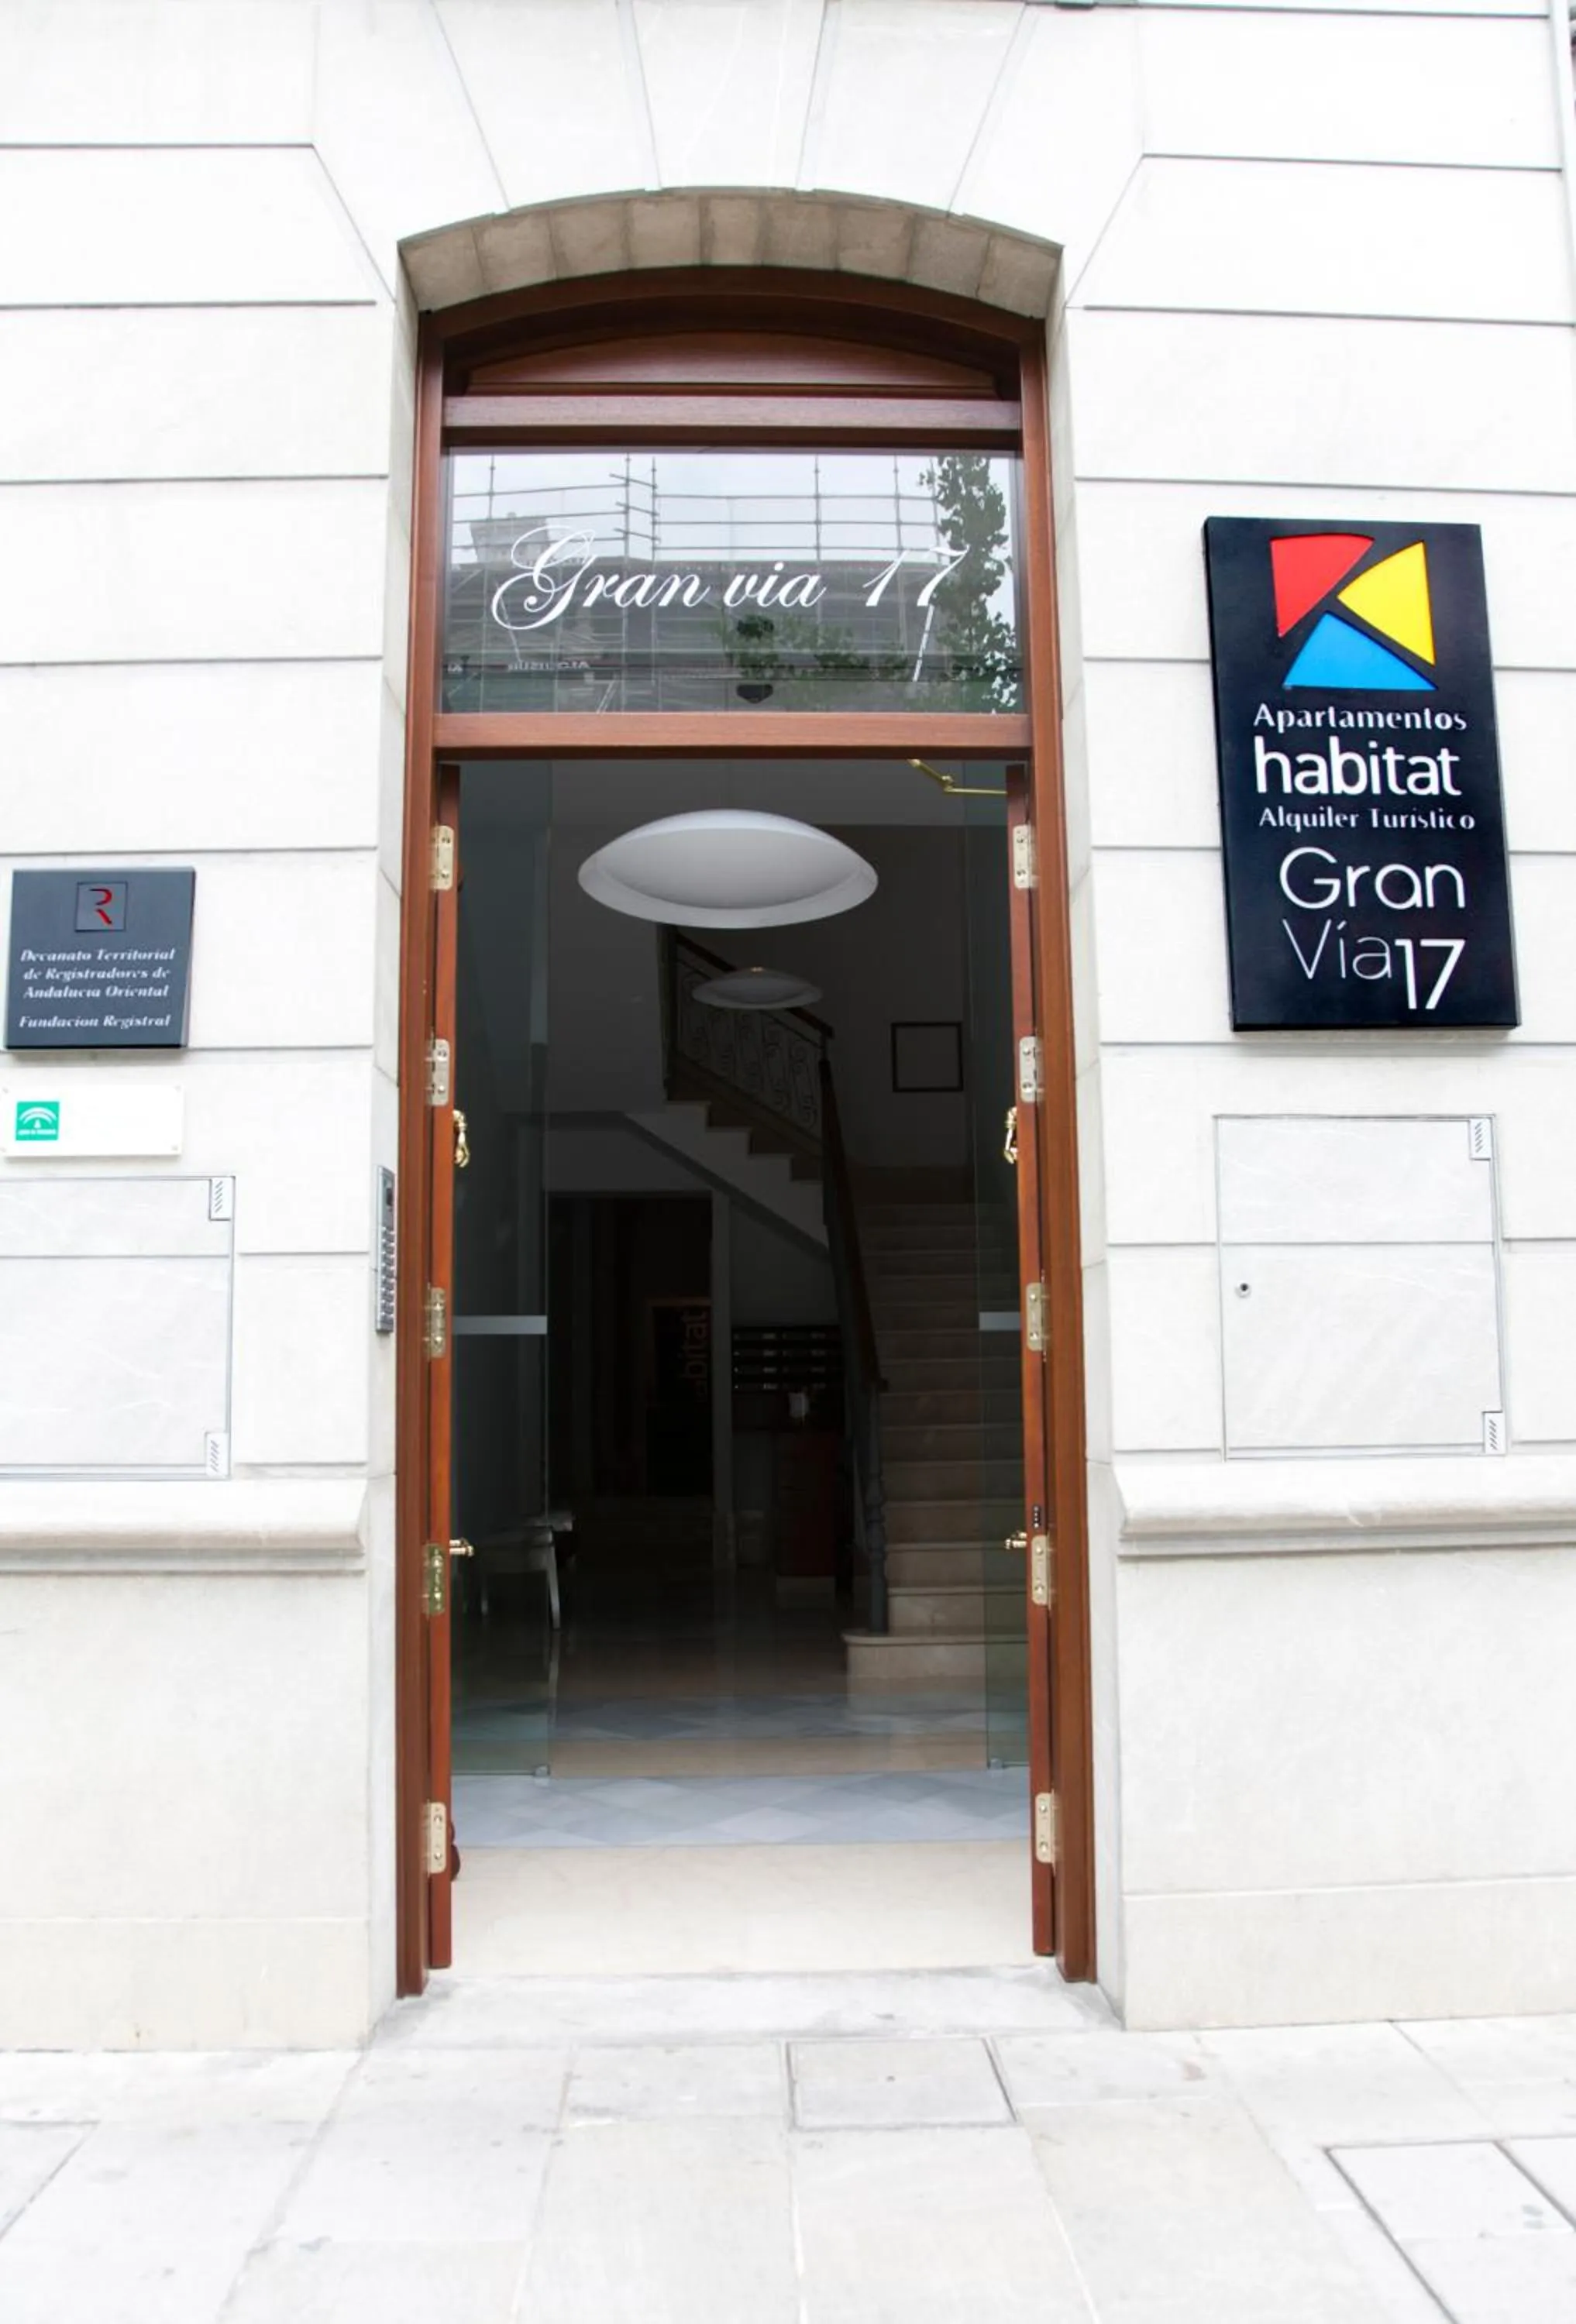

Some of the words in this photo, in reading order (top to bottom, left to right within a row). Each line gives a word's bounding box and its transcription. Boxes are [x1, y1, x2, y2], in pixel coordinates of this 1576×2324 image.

[491, 524, 711, 630] Gran
[723, 562, 827, 607] via
[1253, 703, 1468, 734] Apartamentos
[1253, 735, 1463, 796] habitat
[1259, 805, 1360, 834] Alquiler
[1279, 846, 1467, 910] Gran
[20, 949, 92, 962] Decanato
[96, 948, 176, 961] Territorial
[23, 968, 42, 980] de
[45, 967, 149, 982] Registradores
[152, 967, 171, 978] de
[105, 985, 170, 997] Oriental
[102, 1014, 171, 1029] Registral
